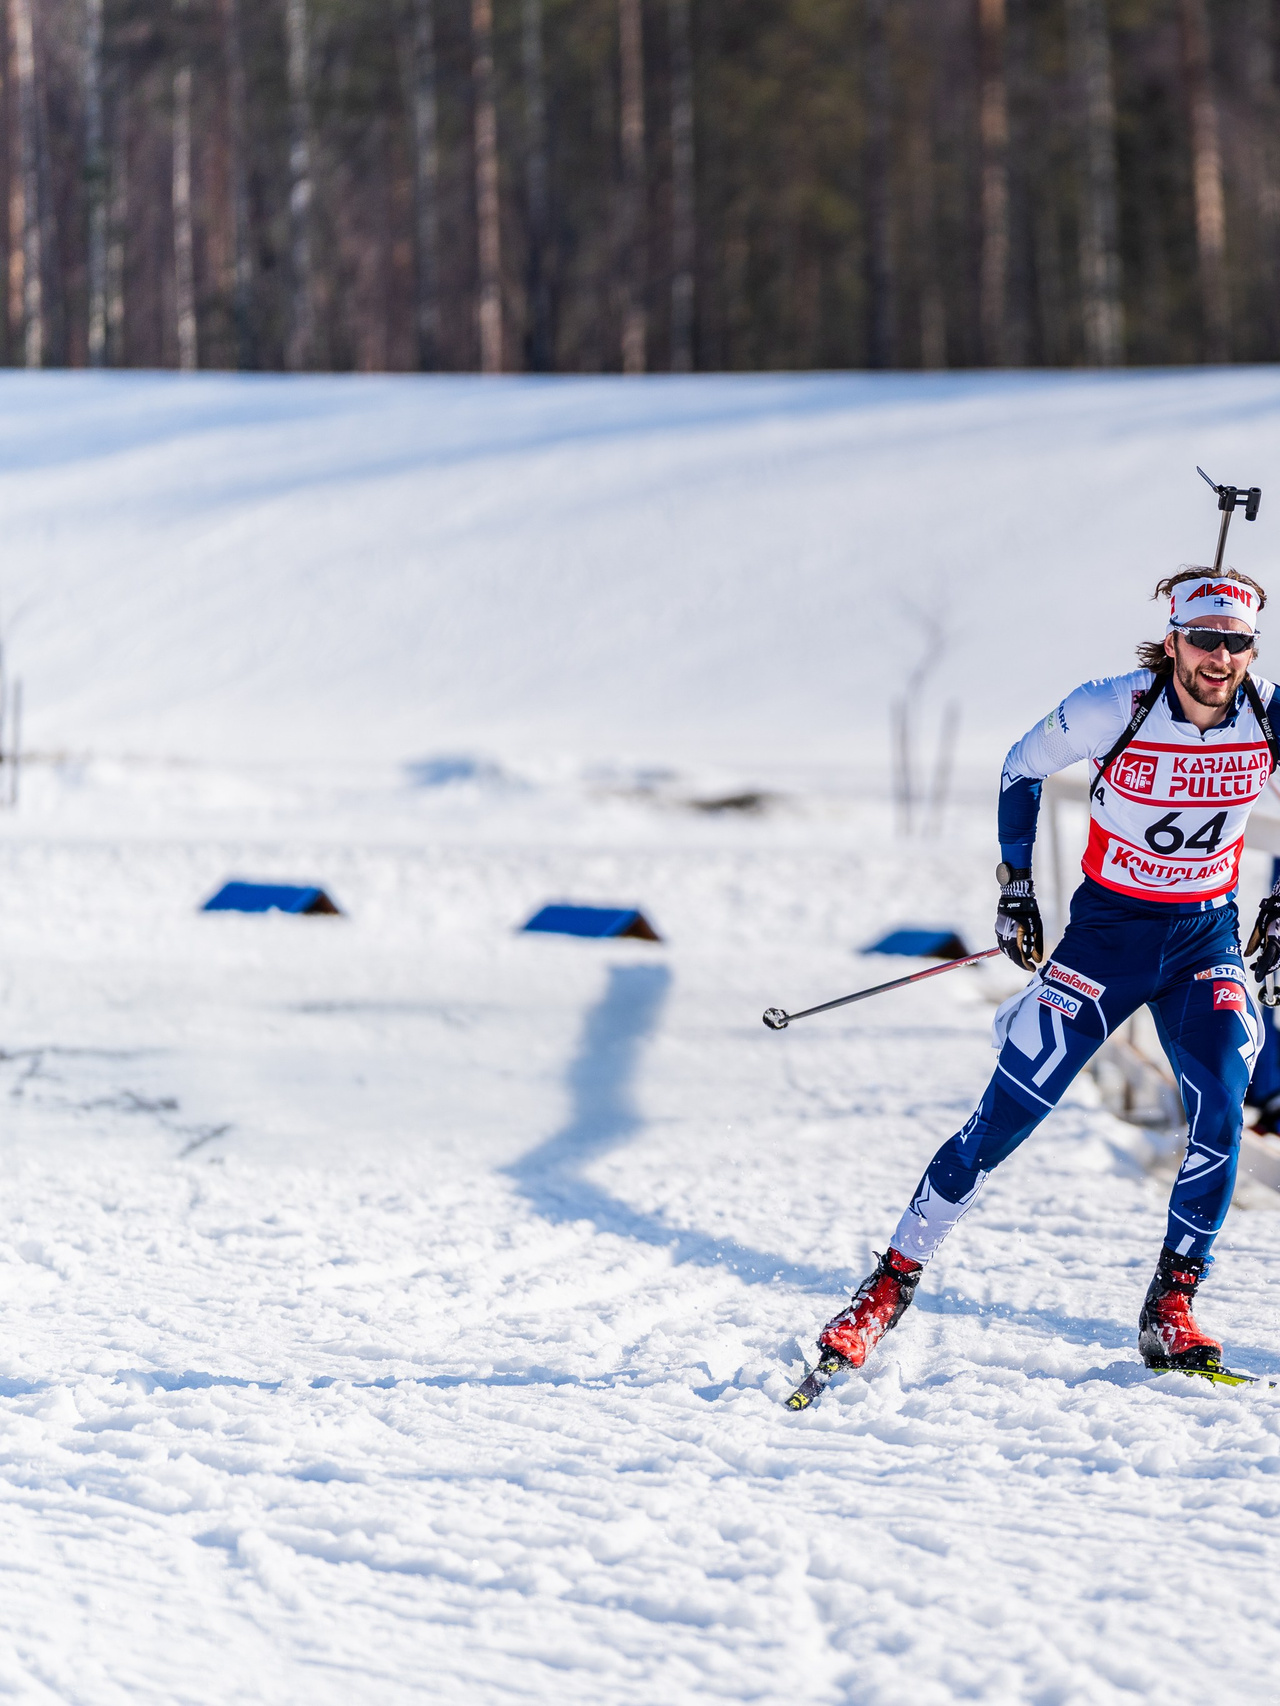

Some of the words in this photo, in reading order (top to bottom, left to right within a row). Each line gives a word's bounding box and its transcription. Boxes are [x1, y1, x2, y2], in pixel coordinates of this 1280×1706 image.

[1185, 583, 1253, 608] AVANT
[1172, 752, 1268, 774] KARJALAN
[1168, 773, 1253, 798] PULTTI
[1144, 811, 1229, 855] 64
[1048, 964, 1100, 998] Terrafame
[1039, 988, 1078, 1013] ATENO
[1214, 987, 1245, 1005] Rex
